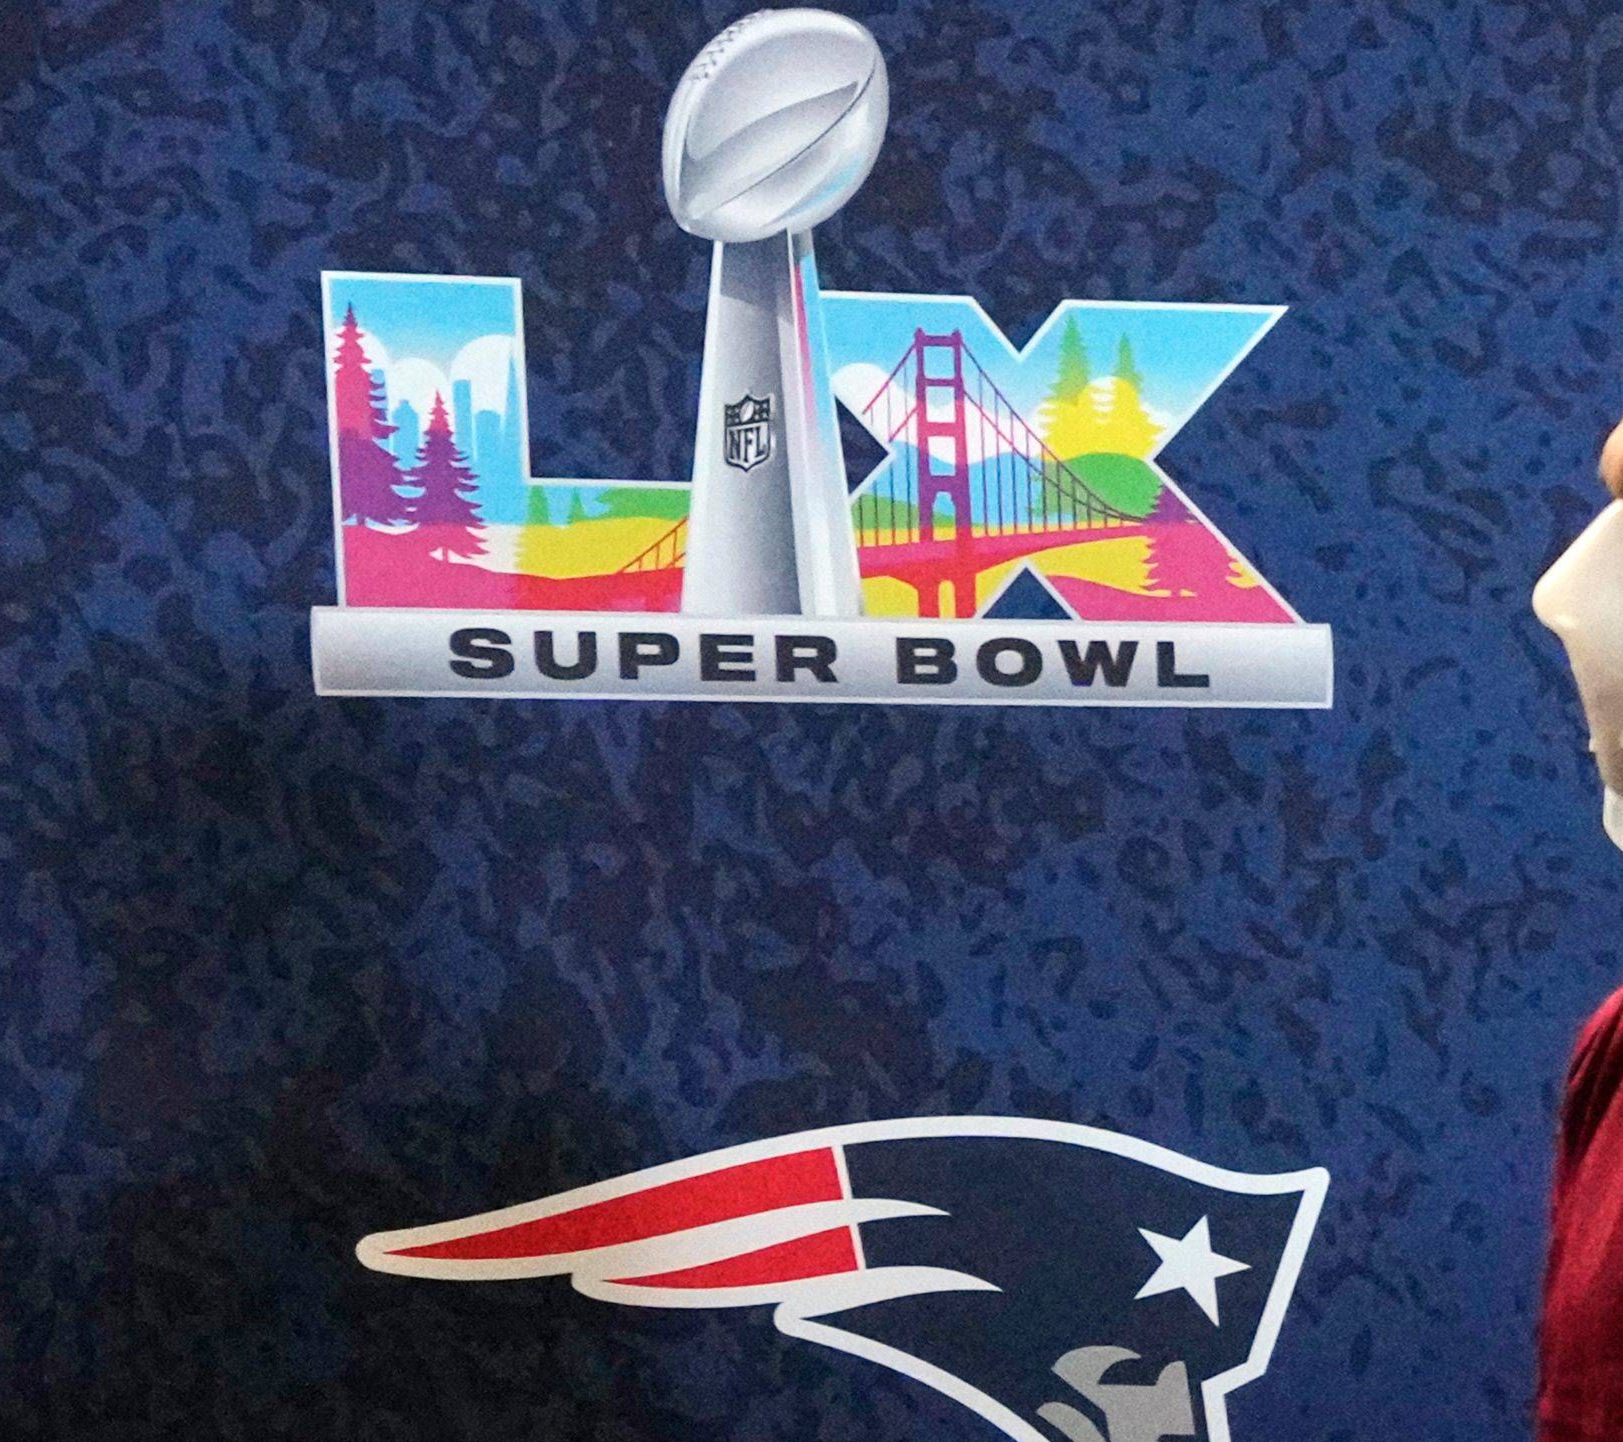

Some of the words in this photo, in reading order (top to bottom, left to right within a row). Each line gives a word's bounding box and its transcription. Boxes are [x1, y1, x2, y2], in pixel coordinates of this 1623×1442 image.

[728, 425, 768, 463] NFL
[449, 628, 842, 685] SUPER
[895, 636, 1210, 690] BOWL
